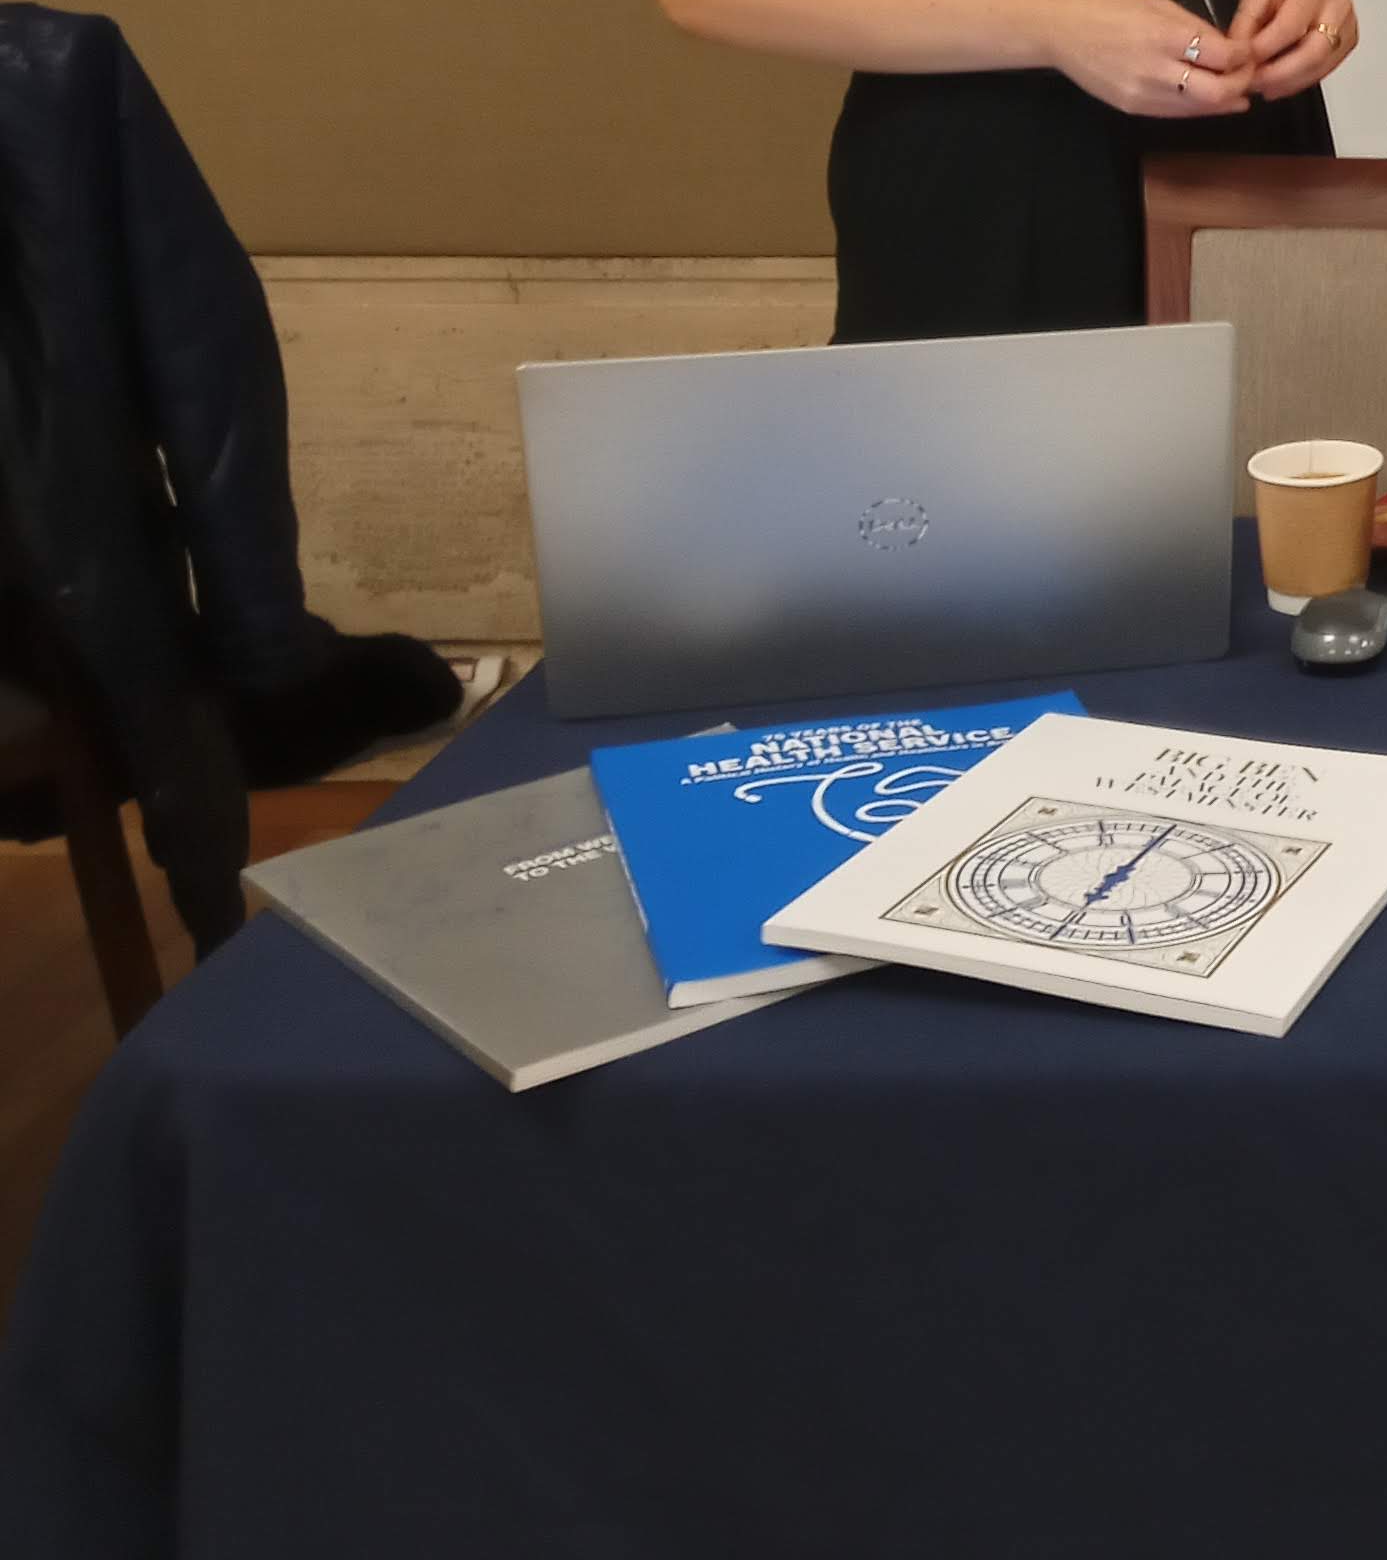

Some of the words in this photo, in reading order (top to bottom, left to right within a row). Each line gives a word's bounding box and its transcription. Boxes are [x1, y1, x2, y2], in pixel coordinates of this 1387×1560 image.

[749, 722, 946, 758] NATIONAL
[888, 717, 924, 728] THE
[687, 744, 843, 779] HEALTH
[851, 725, 1016, 756] SERVICE
[1155, 748, 1226, 771] BIG
[1239, 759, 1319, 783] BEN
[1095, 775, 1320, 822] WESTMINSTER
[502, 847, 576, 877] FROM
[514, 865, 550, 882] TO
[550, 848, 604, 870] THE
